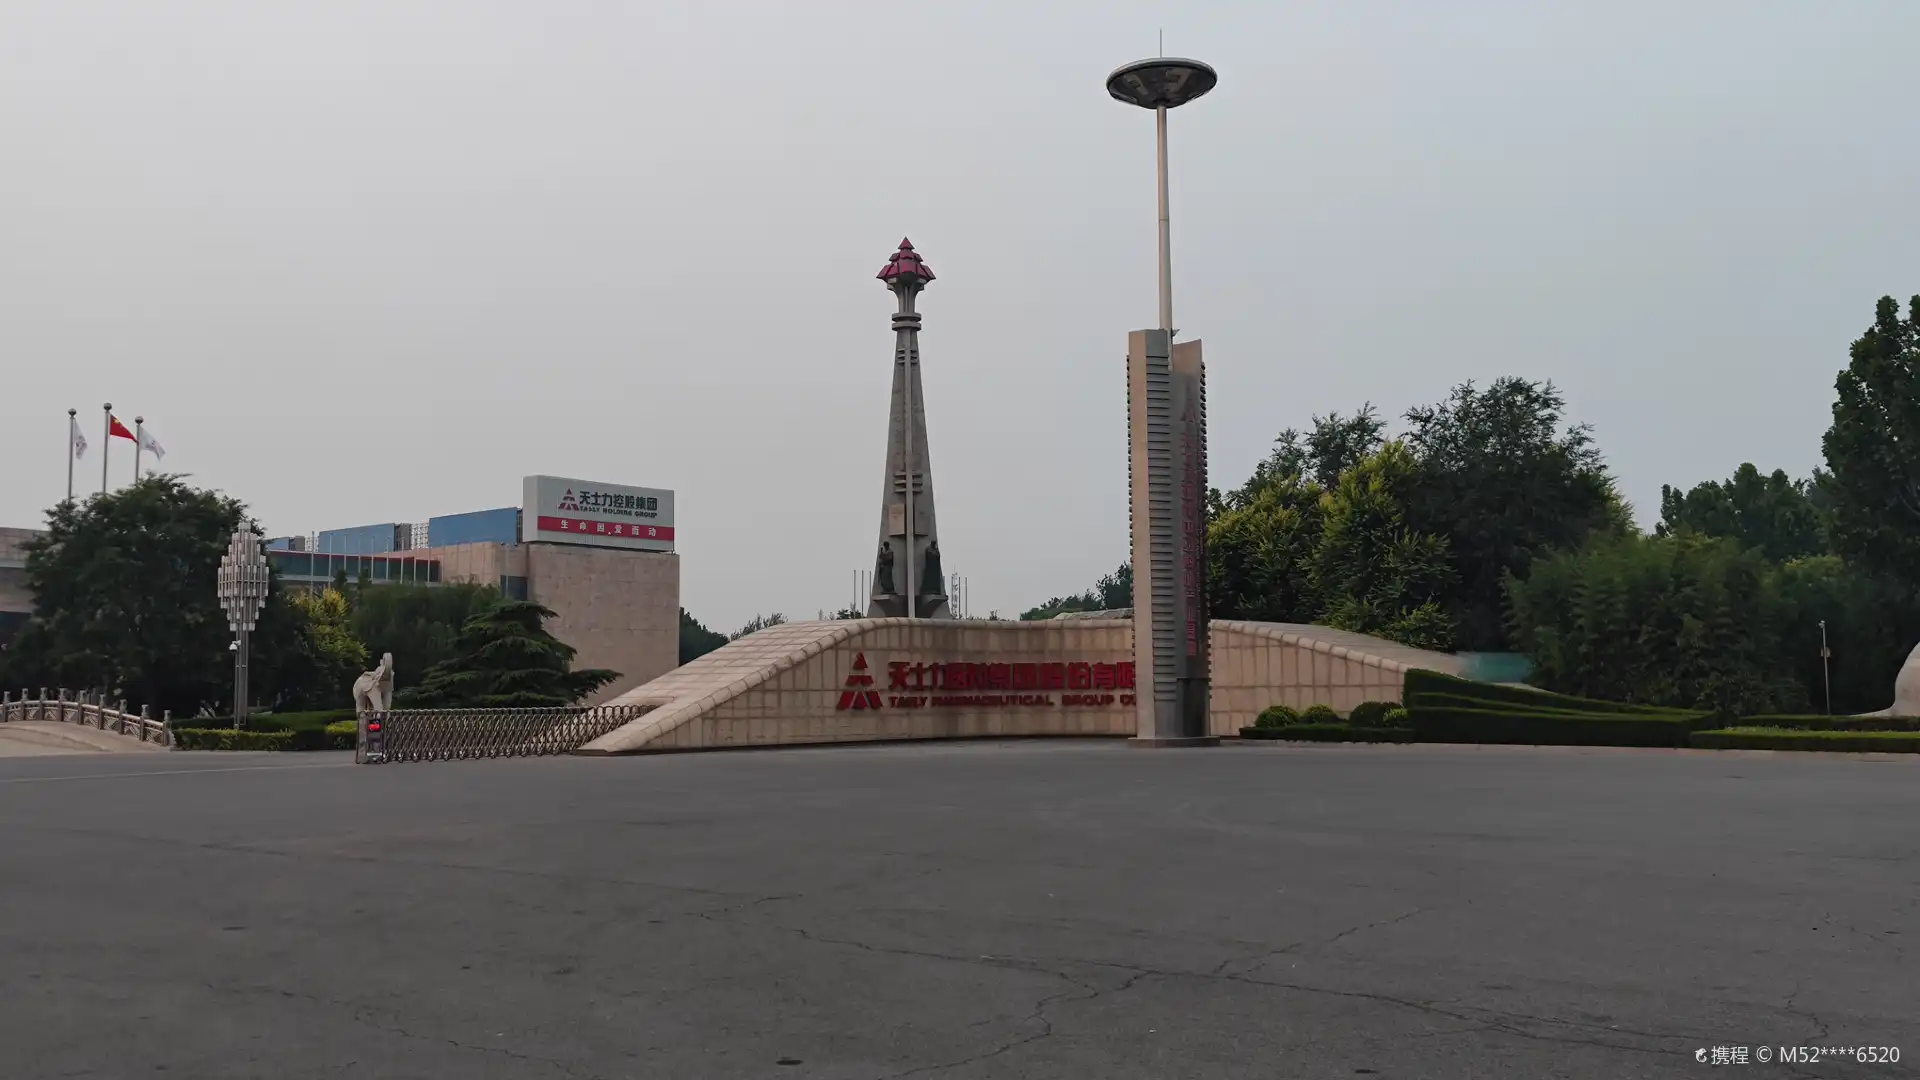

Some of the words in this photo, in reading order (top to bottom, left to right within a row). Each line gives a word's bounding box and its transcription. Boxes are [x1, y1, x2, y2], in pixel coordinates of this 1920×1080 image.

[579, 490, 658, 511] 天士力控股集团
[634, 510, 658, 518] GROUP
[1062, 694, 1115, 707] GROUP
